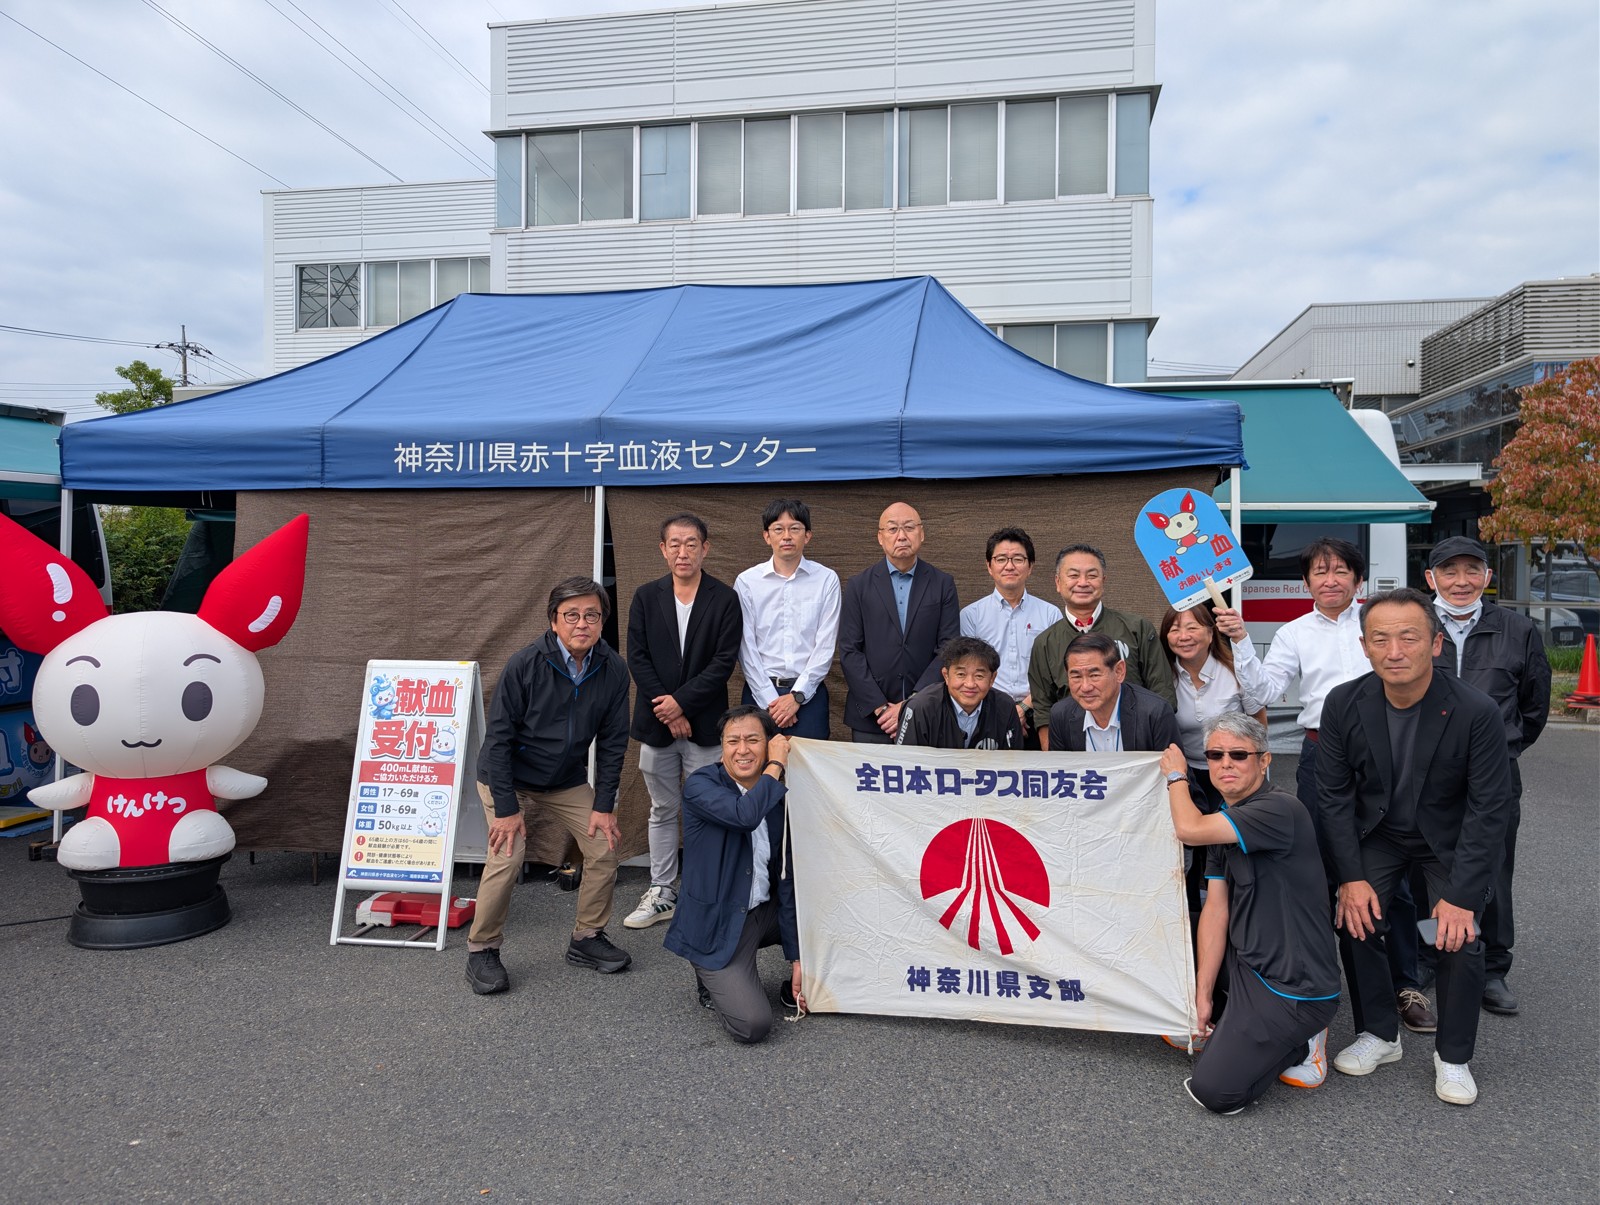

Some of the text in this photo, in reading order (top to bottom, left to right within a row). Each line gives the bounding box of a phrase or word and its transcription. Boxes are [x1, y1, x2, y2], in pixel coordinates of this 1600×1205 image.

[394, 436, 817, 474] 神奈川県赤十字血液センター
[1158, 533, 1235, 582] 献 血
[1178, 557, 1233, 591] お願いします
[1242, 585, 1280, 595] apanese
[1283, 584, 1300, 593] Red
[393, 678, 456, 715] 献血
[370, 720, 438, 758] 受付
[373, 773, 438, 783] ご協力いただける方
[380, 763, 435, 773] 400mL献血に
[855, 762, 1108, 800] 全日本ロータス同友会
[107, 791, 187, 818] けんけつ
[362, 788, 377, 796] 男性
[360, 804, 375, 813] 女性
[358, 821, 373, 829] 体重
[906, 964, 1087, 1003] 神奈川県支部
